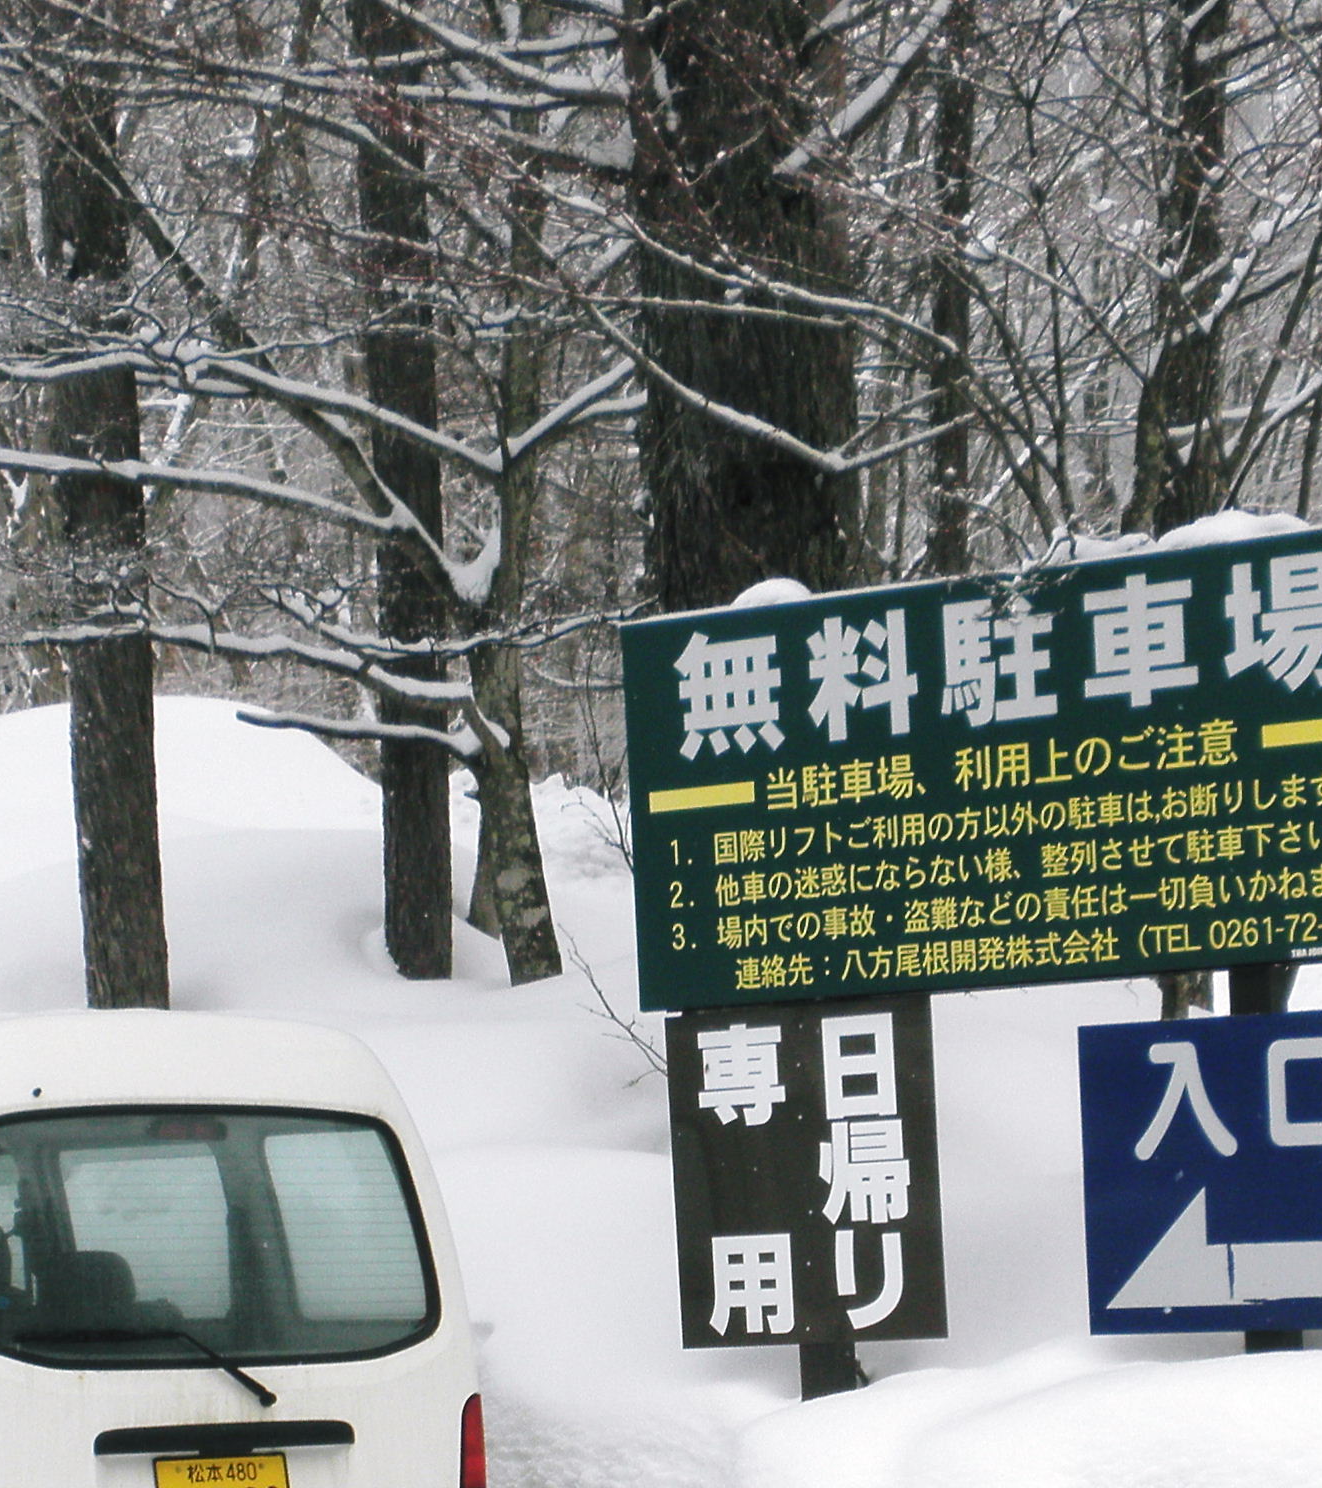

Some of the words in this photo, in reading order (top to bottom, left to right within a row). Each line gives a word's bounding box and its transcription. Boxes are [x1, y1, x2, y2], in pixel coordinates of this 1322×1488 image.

[697, 1024, 795, 1337] 専用
[818, 1012, 911, 1330] 日帰り
